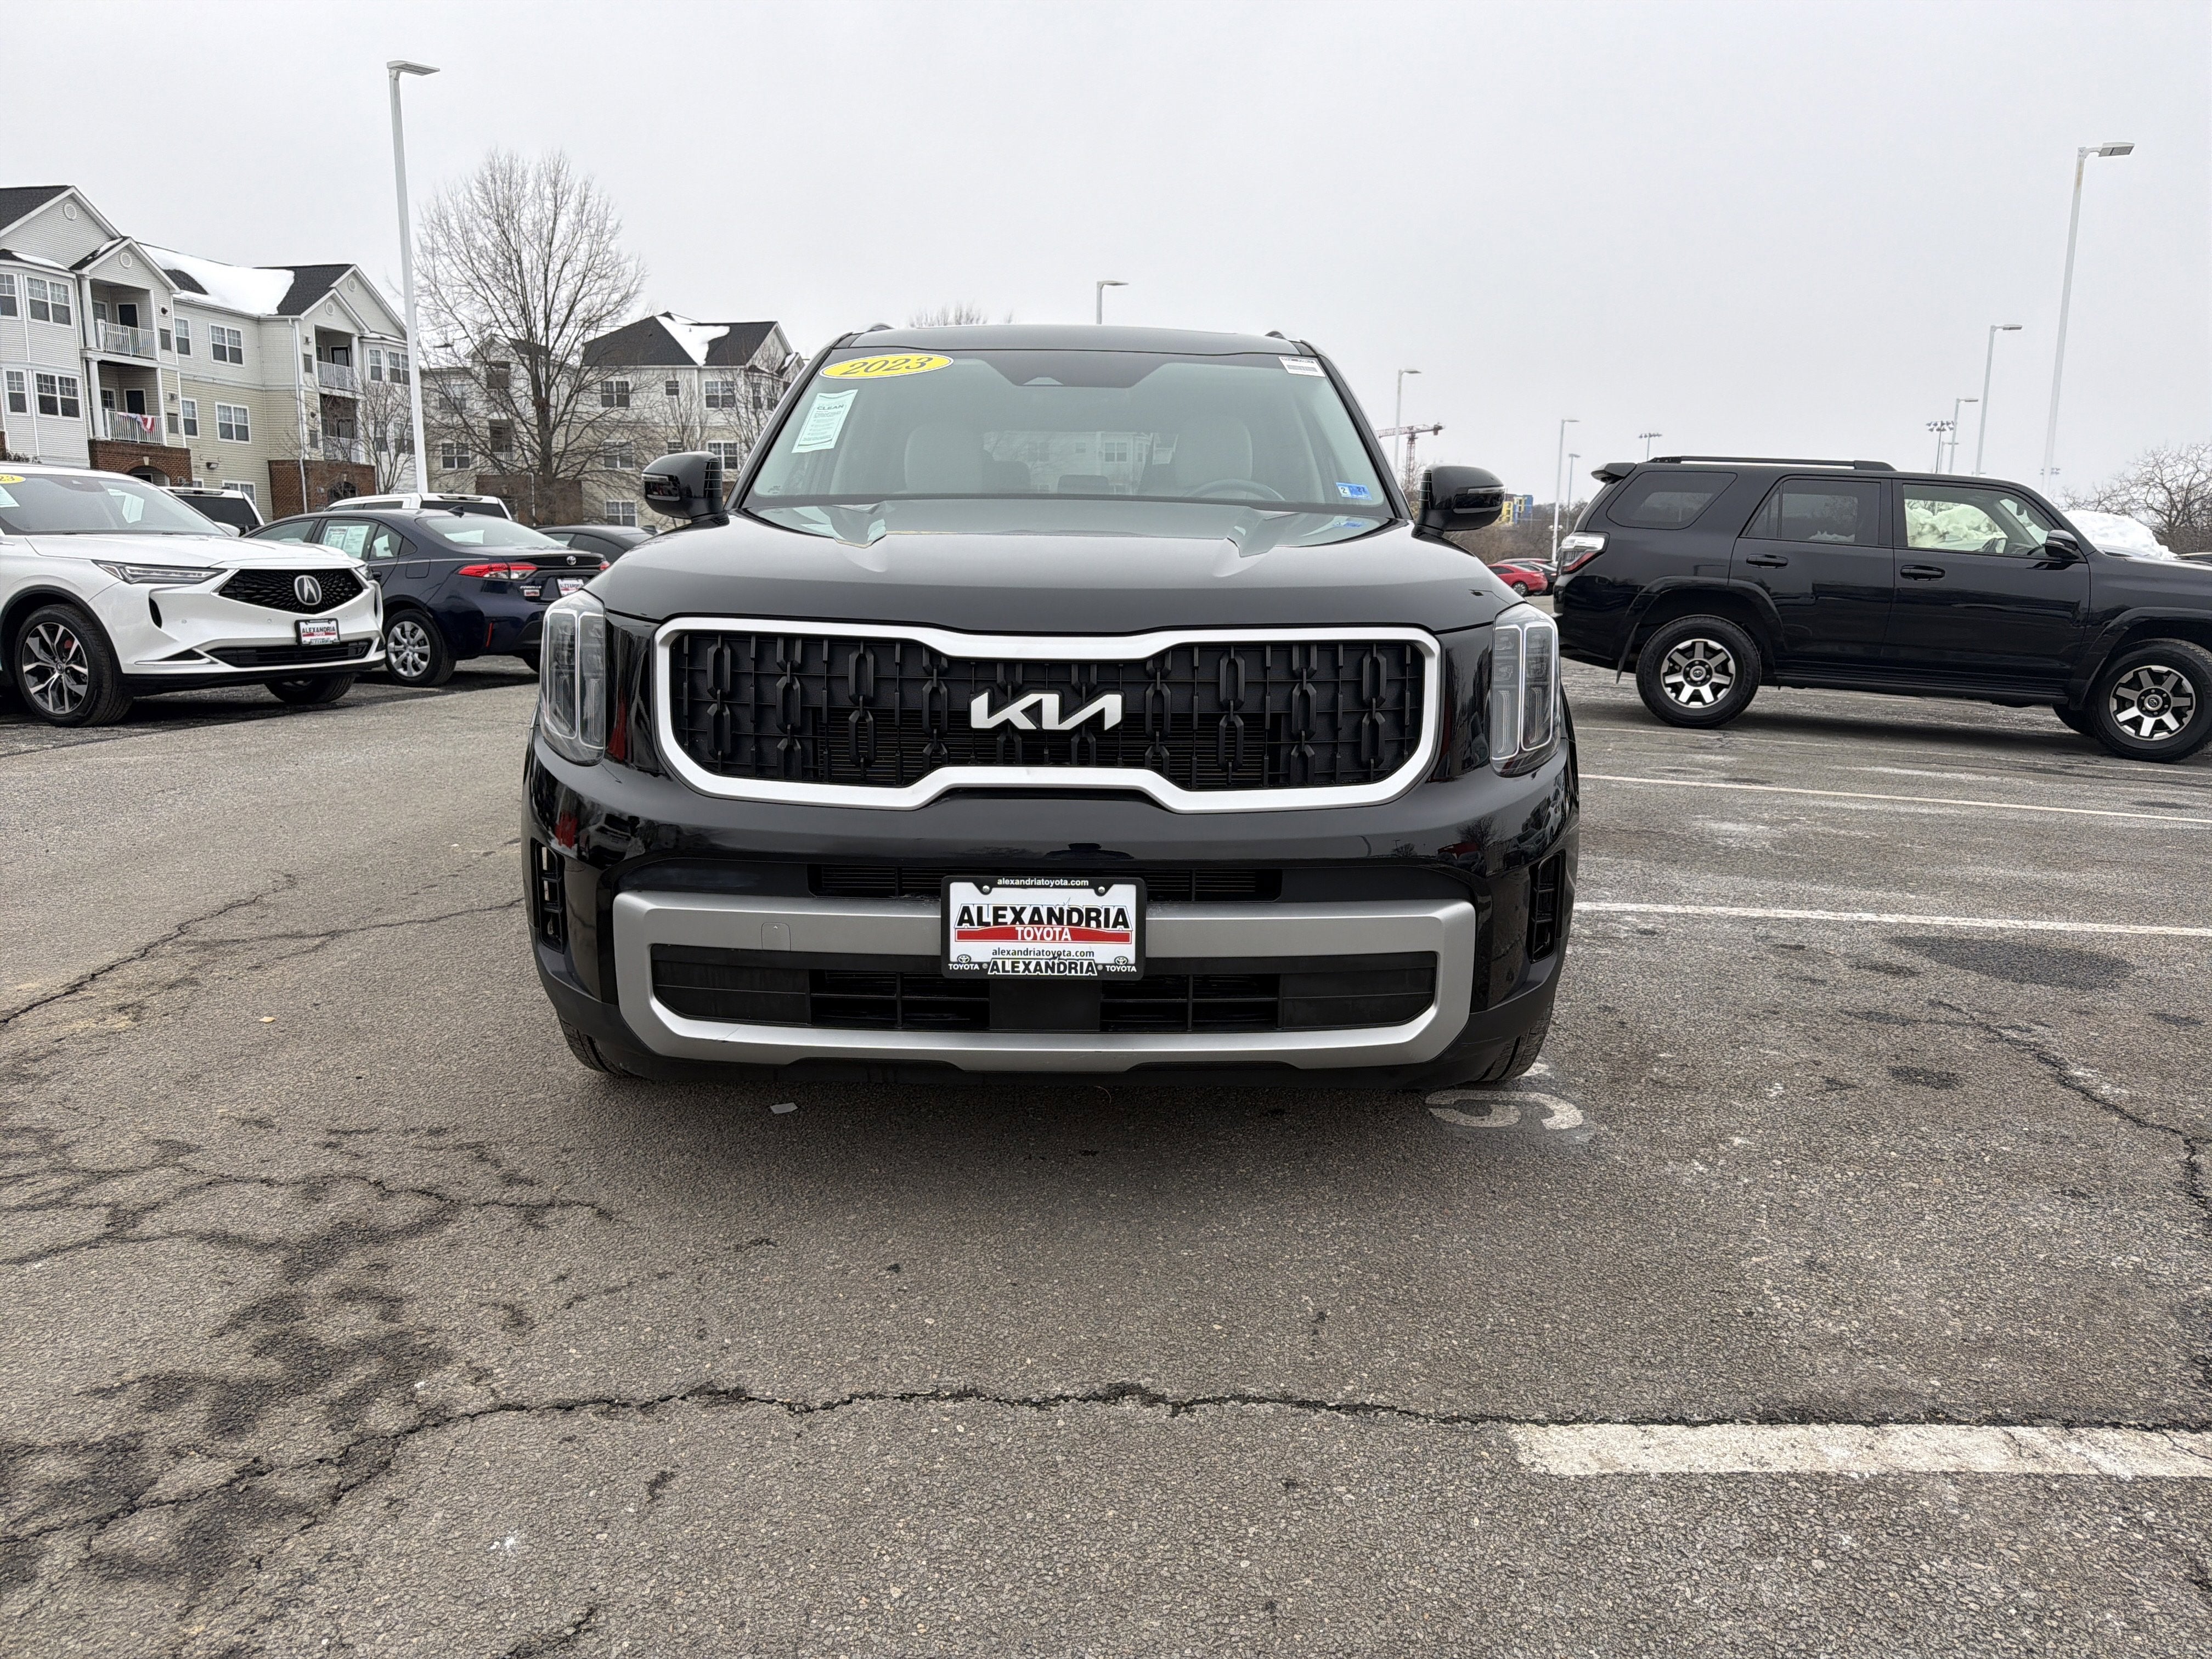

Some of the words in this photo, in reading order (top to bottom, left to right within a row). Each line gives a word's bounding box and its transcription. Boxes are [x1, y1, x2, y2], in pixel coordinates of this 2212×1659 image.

[839, 357, 934, 376] 2023
[970, 692, 1122, 731] KIA
[997, 878, 1089, 887] alexandriatoyota.com
[956, 905, 1131, 930] ALEXANDRIA
[1015, 927, 1071, 941] TOYOTA
[992, 947, 1094, 958] alexandriatoyota.com
[988, 959, 1097, 975] ALEXANDRIA
